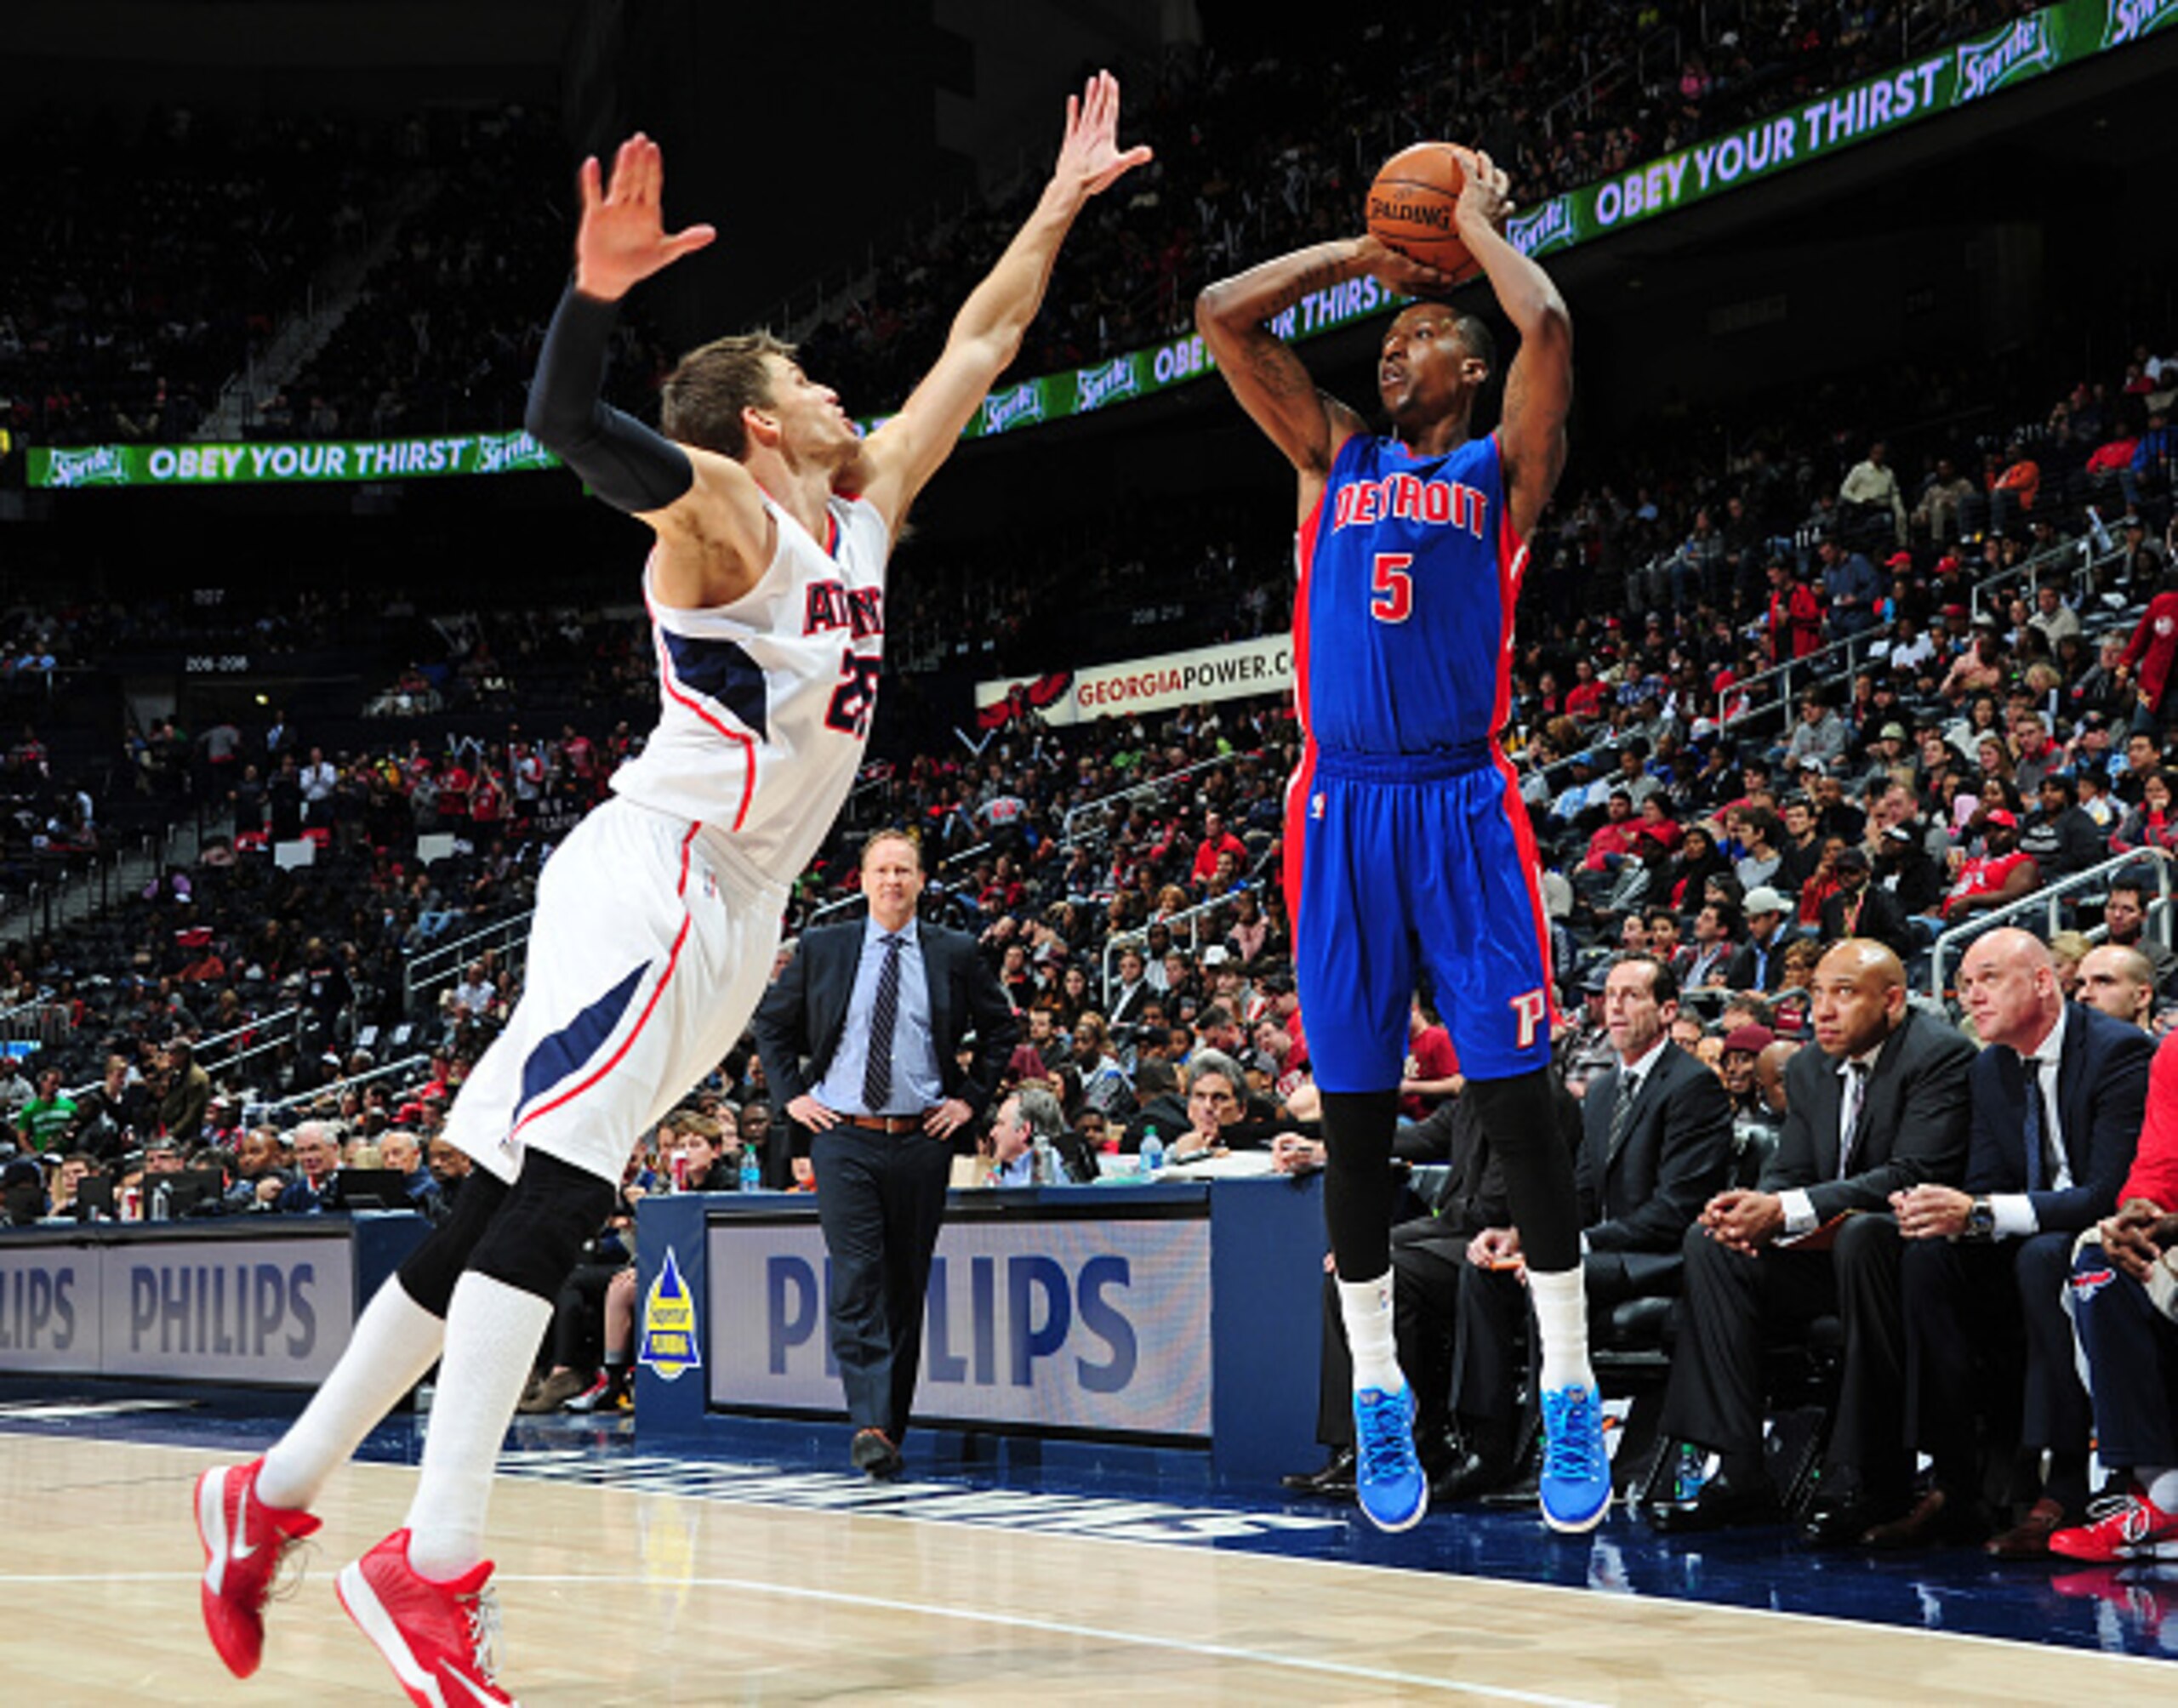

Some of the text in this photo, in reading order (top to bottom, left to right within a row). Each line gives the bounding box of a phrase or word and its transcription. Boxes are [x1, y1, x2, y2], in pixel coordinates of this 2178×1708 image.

[1595, 153, 1688, 225] OBEY
[1694, 117, 1796, 190] YOUR
[1802, 56, 1946, 151] THIRST
[150, 447, 244, 478] OBEY
[251, 445, 346, 476] YOUR
[354, 438, 467, 475] THIRST
[1331, 472, 1487, 539] DETROIT
[1371, 553, 1413, 623] 5
[1077, 649, 1294, 707] GEORGIAPOWER.C
[130, 1262, 316, 1359] PHILIPS
[767, 1255, 1137, 1394] PLIPS
